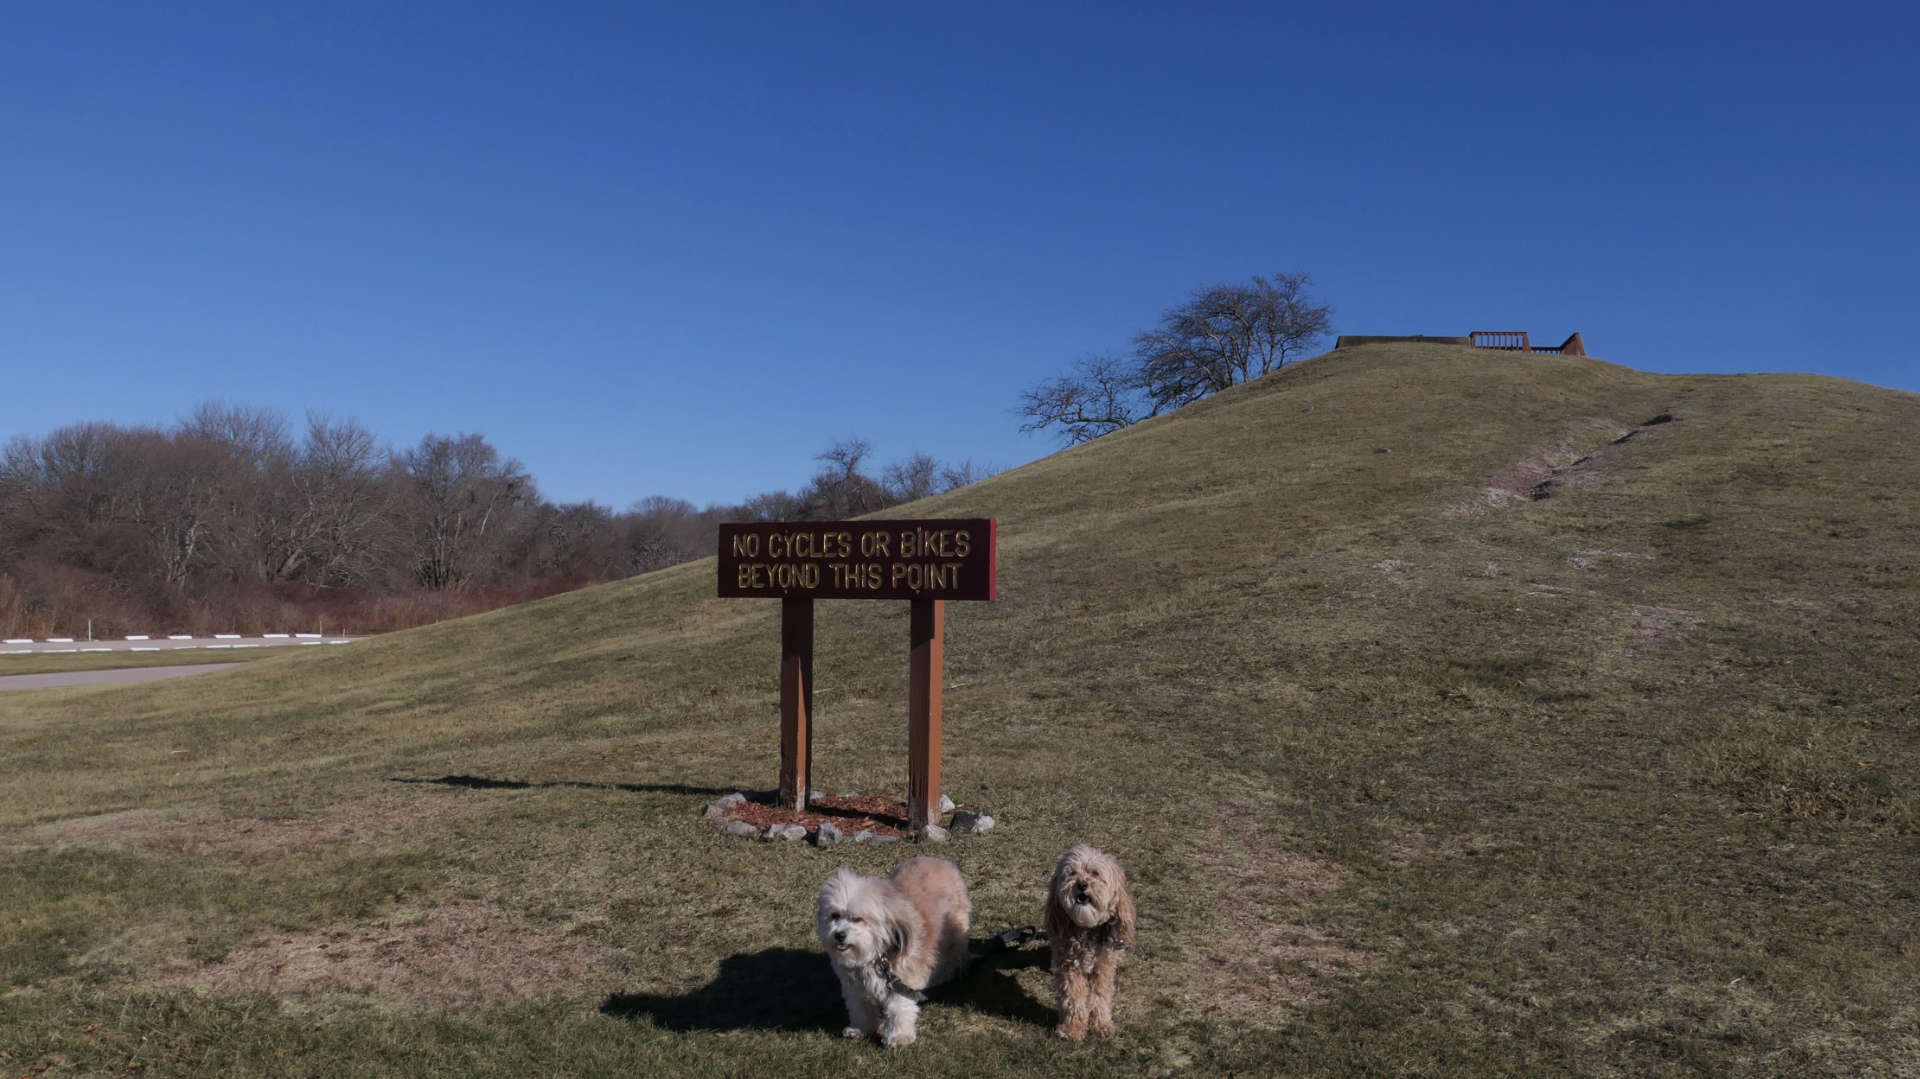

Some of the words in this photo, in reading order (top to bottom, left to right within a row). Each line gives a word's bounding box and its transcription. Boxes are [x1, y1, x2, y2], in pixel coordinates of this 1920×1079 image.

[733, 533, 760, 558] NO
[768, 532, 852, 558] CYCLES
[861, 532, 891, 557] OR
[900, 530, 971, 558] BIKES
[738, 563, 820, 589] BEYOND
[828, 563, 882, 589] THIS
[892, 562, 964, 590] POINT
